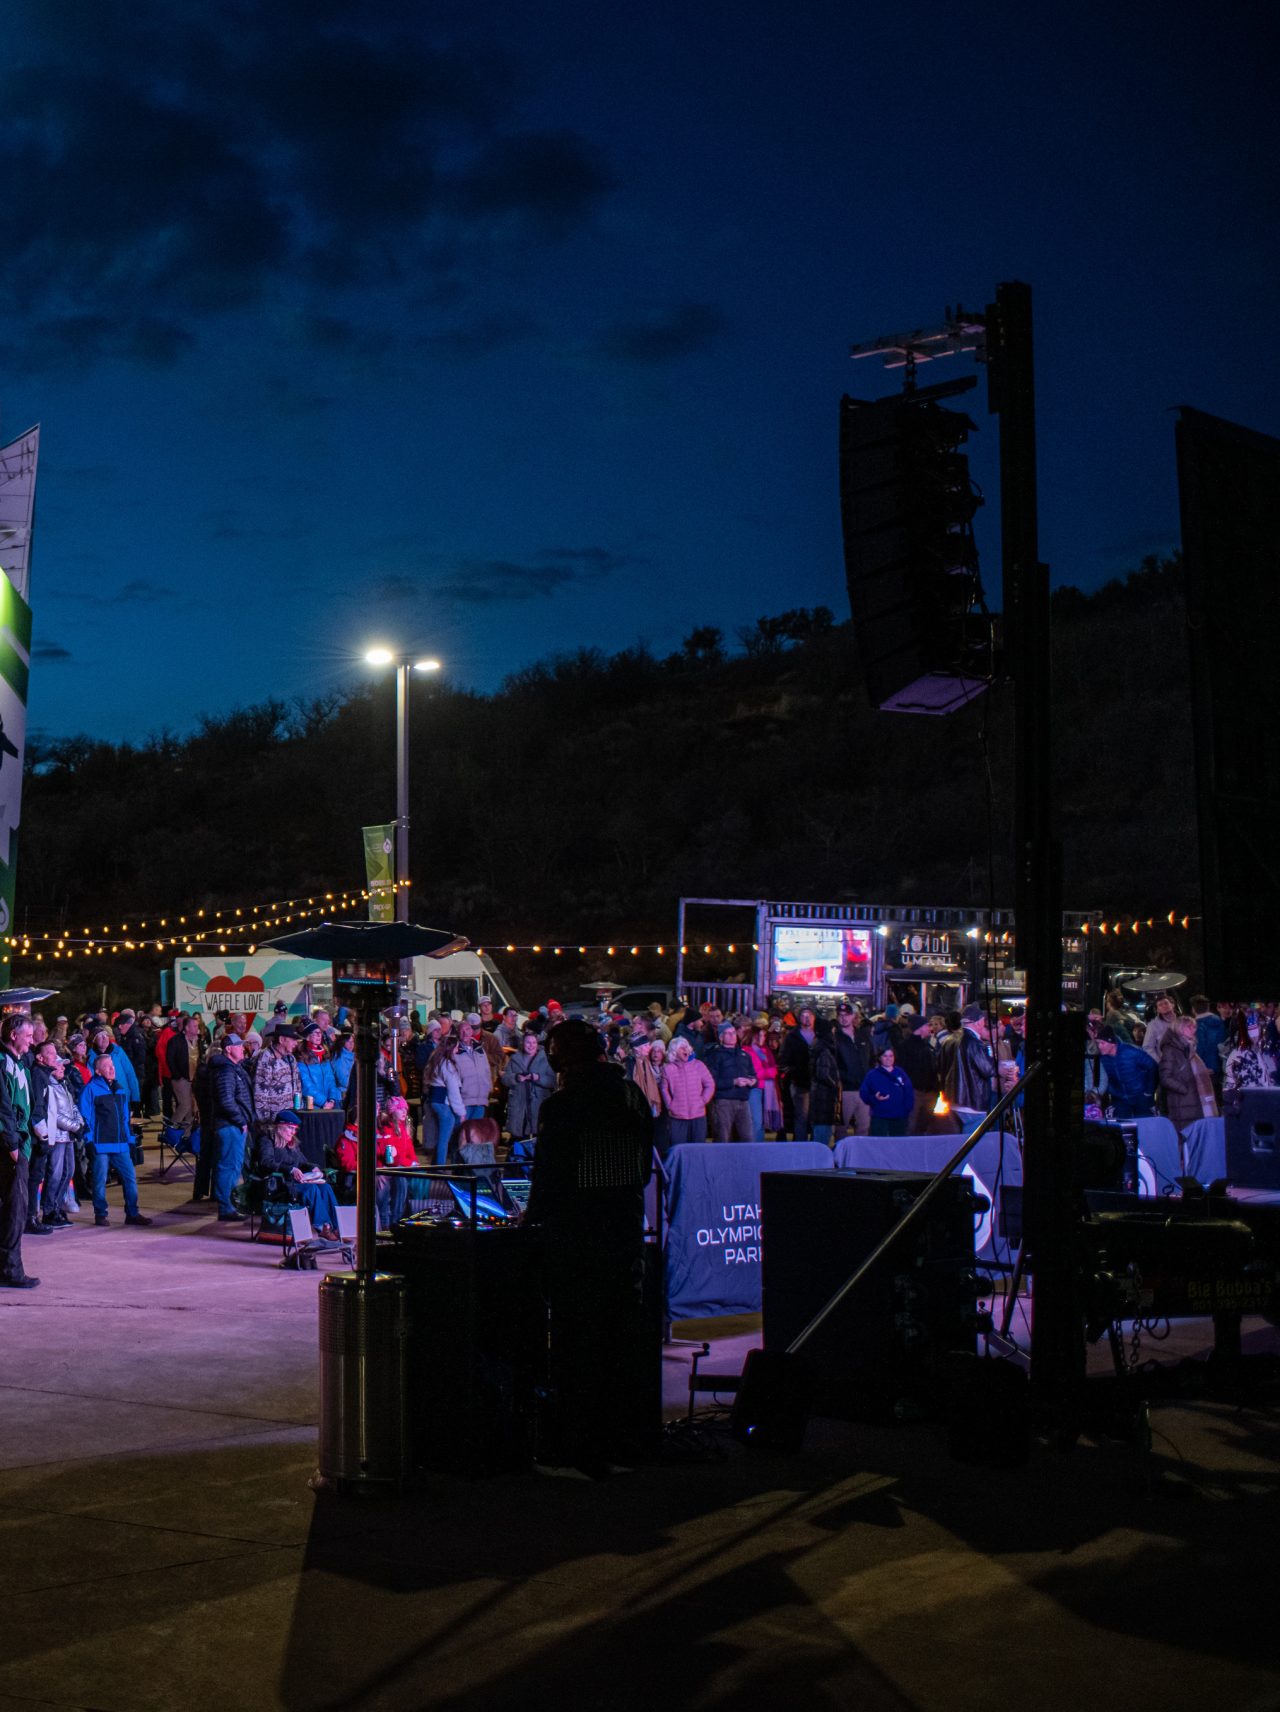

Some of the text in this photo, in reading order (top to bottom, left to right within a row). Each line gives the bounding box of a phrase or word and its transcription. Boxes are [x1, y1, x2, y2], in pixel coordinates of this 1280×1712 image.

[205, 993, 264, 1011] WAFFLE LOVE
[725, 1246, 762, 1265] PAR
